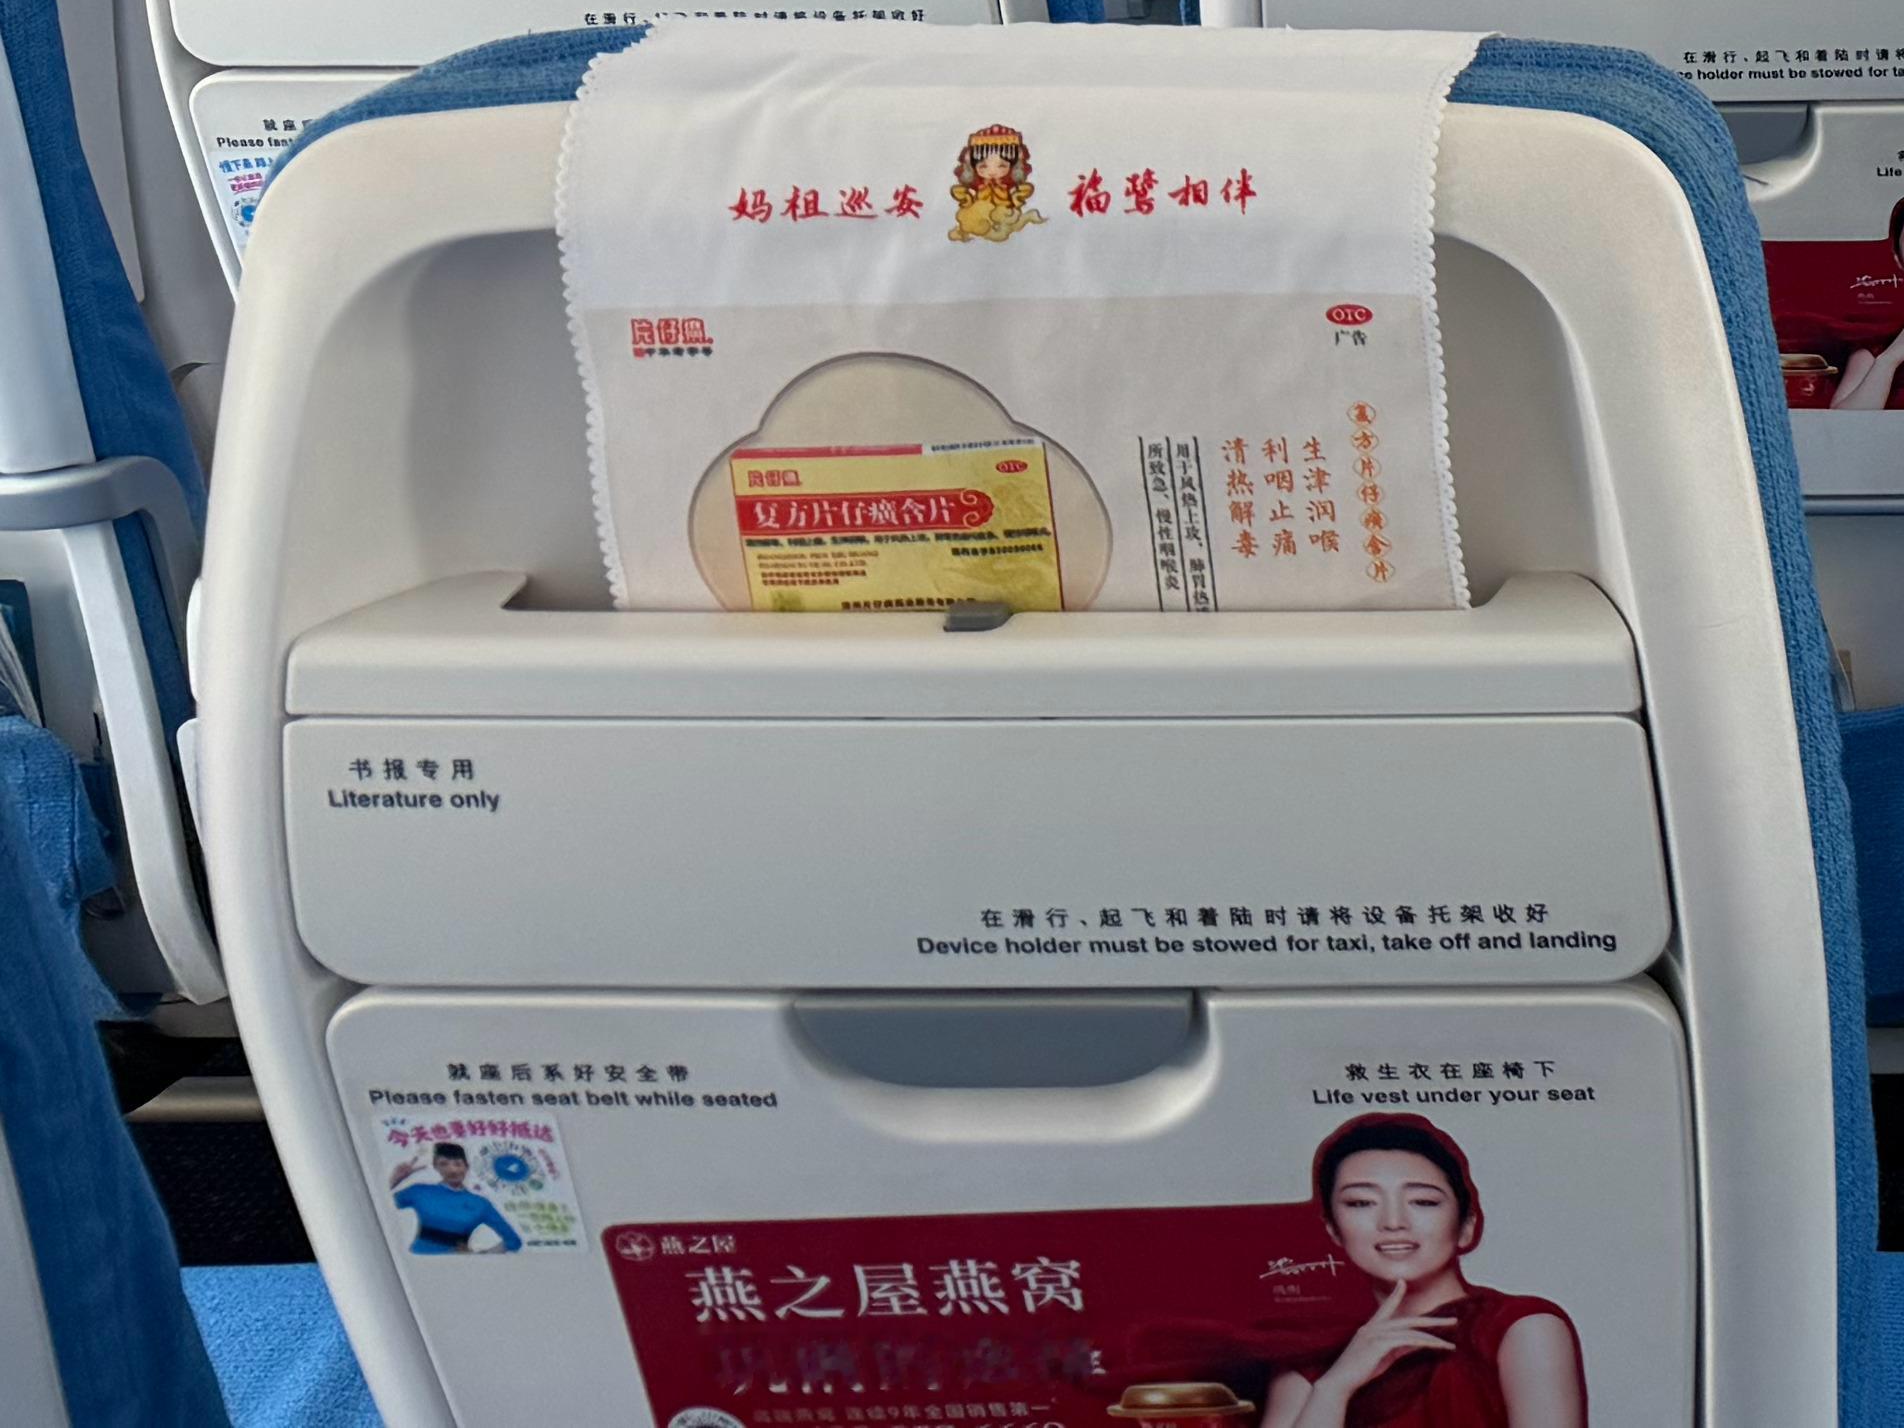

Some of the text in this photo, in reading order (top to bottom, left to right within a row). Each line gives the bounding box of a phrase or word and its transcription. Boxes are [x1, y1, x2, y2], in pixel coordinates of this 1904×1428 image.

[1876, 165, 1903, 178] Life
[727, 185, 926, 224] 妈祖巡安
[1067, 167, 1260, 219] 福鹭相伴
[1221, 437, 1258, 558] 清热解毒
[1262, 436, 1297, 556] 利咽止痛
[1302, 436, 1340, 552] 生津润喉
[1347, 401, 1395, 582] 复方片仔癀含片
[753, 496, 955, 529] 复方片仔癀含片
[348, 758, 475, 781] 书报专用
[328, 789, 500, 813] Literature only
[980, 903, 1550, 930] 在滑行、起飞和着陆时请将设备托架收好
[917, 930, 1617, 955] Device holder must be stowed for taxi, take off and landing
[447, 1063, 690, 1083] 就座后系好安全带
[1345, 1060, 1555, 1082] 救生衣在座椅下
[369, 1089, 778, 1109] Please fasten seat belt while seated
[1313, 1085, 1595, 1107] Life vest under your seat
[660, 1234, 737, 1256] 燕之屋
[690, 1256, 1086, 1323] 燕之屋燕窝
